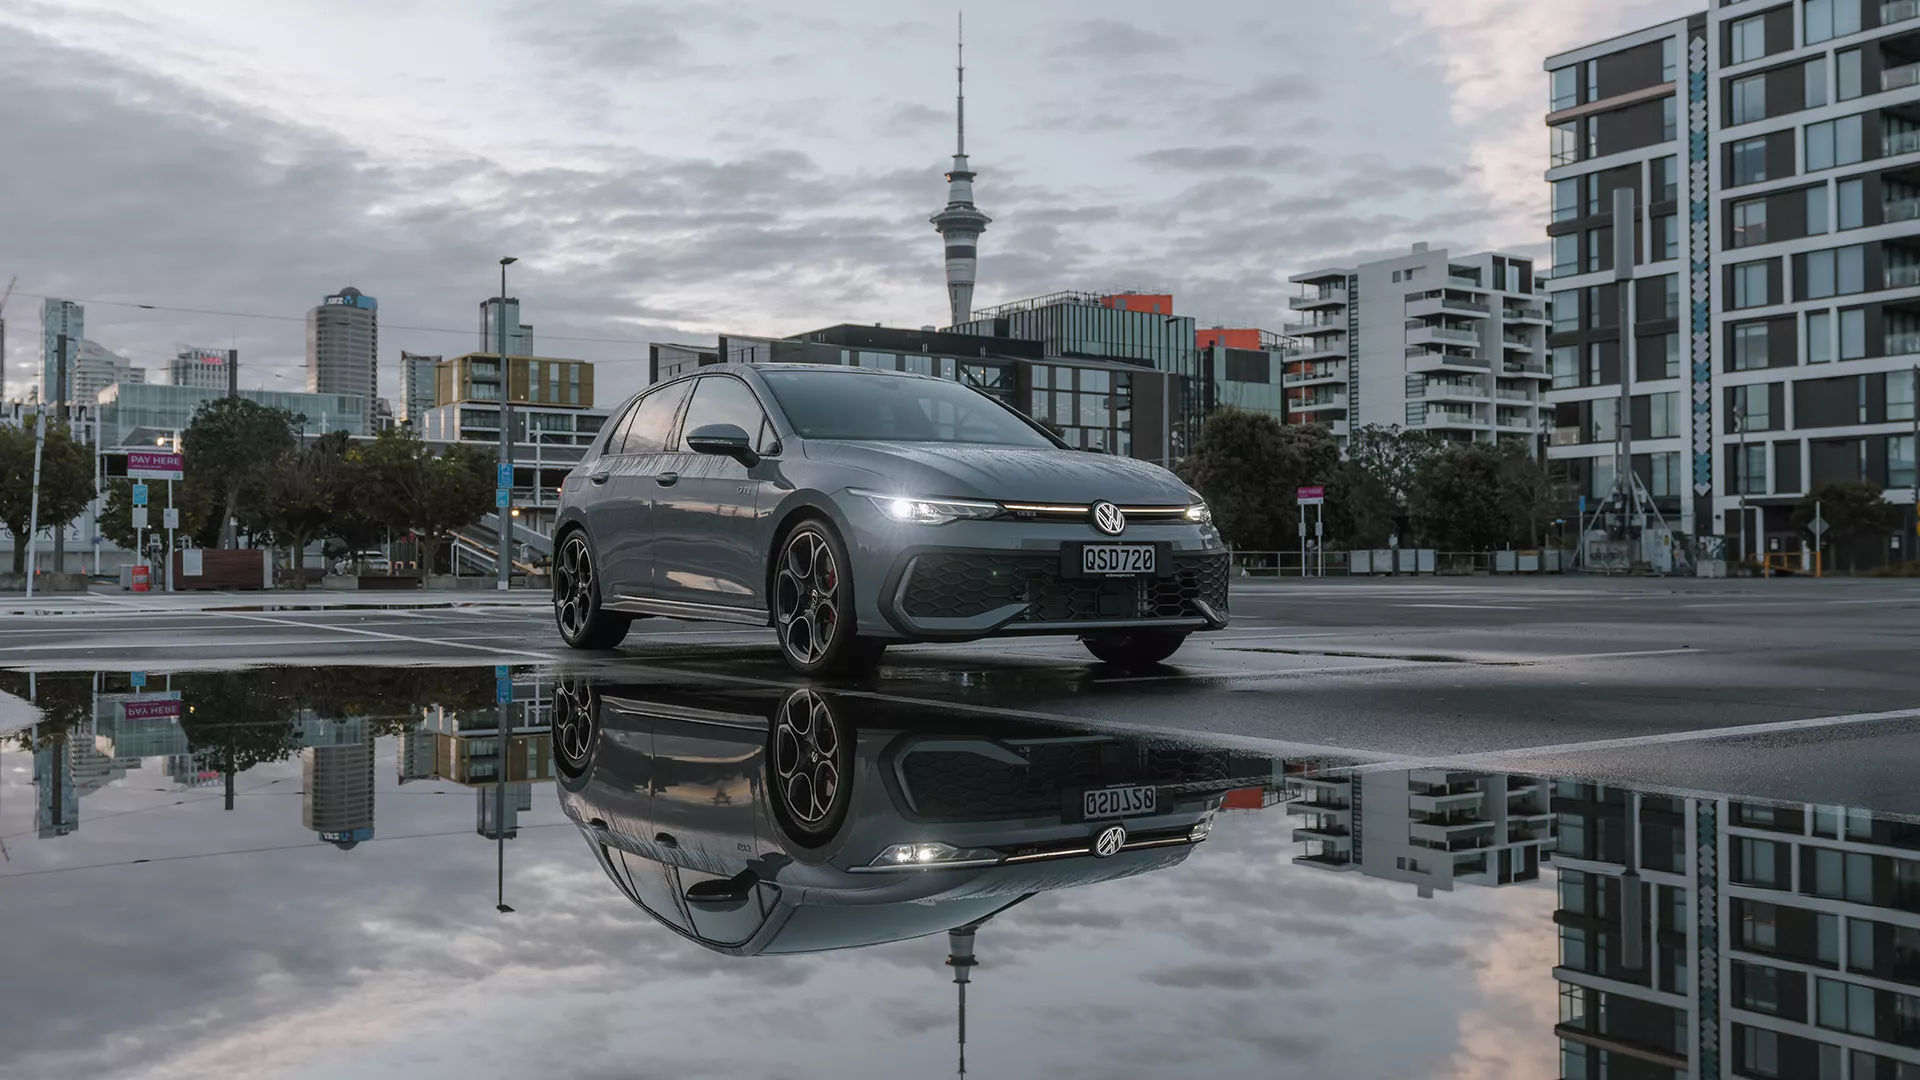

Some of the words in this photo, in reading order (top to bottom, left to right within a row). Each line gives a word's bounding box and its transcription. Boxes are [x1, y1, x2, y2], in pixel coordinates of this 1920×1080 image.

[131, 455, 150, 464] PAY
[153, 457, 180, 466] HERE
[1085, 548, 1153, 571] QSD720
